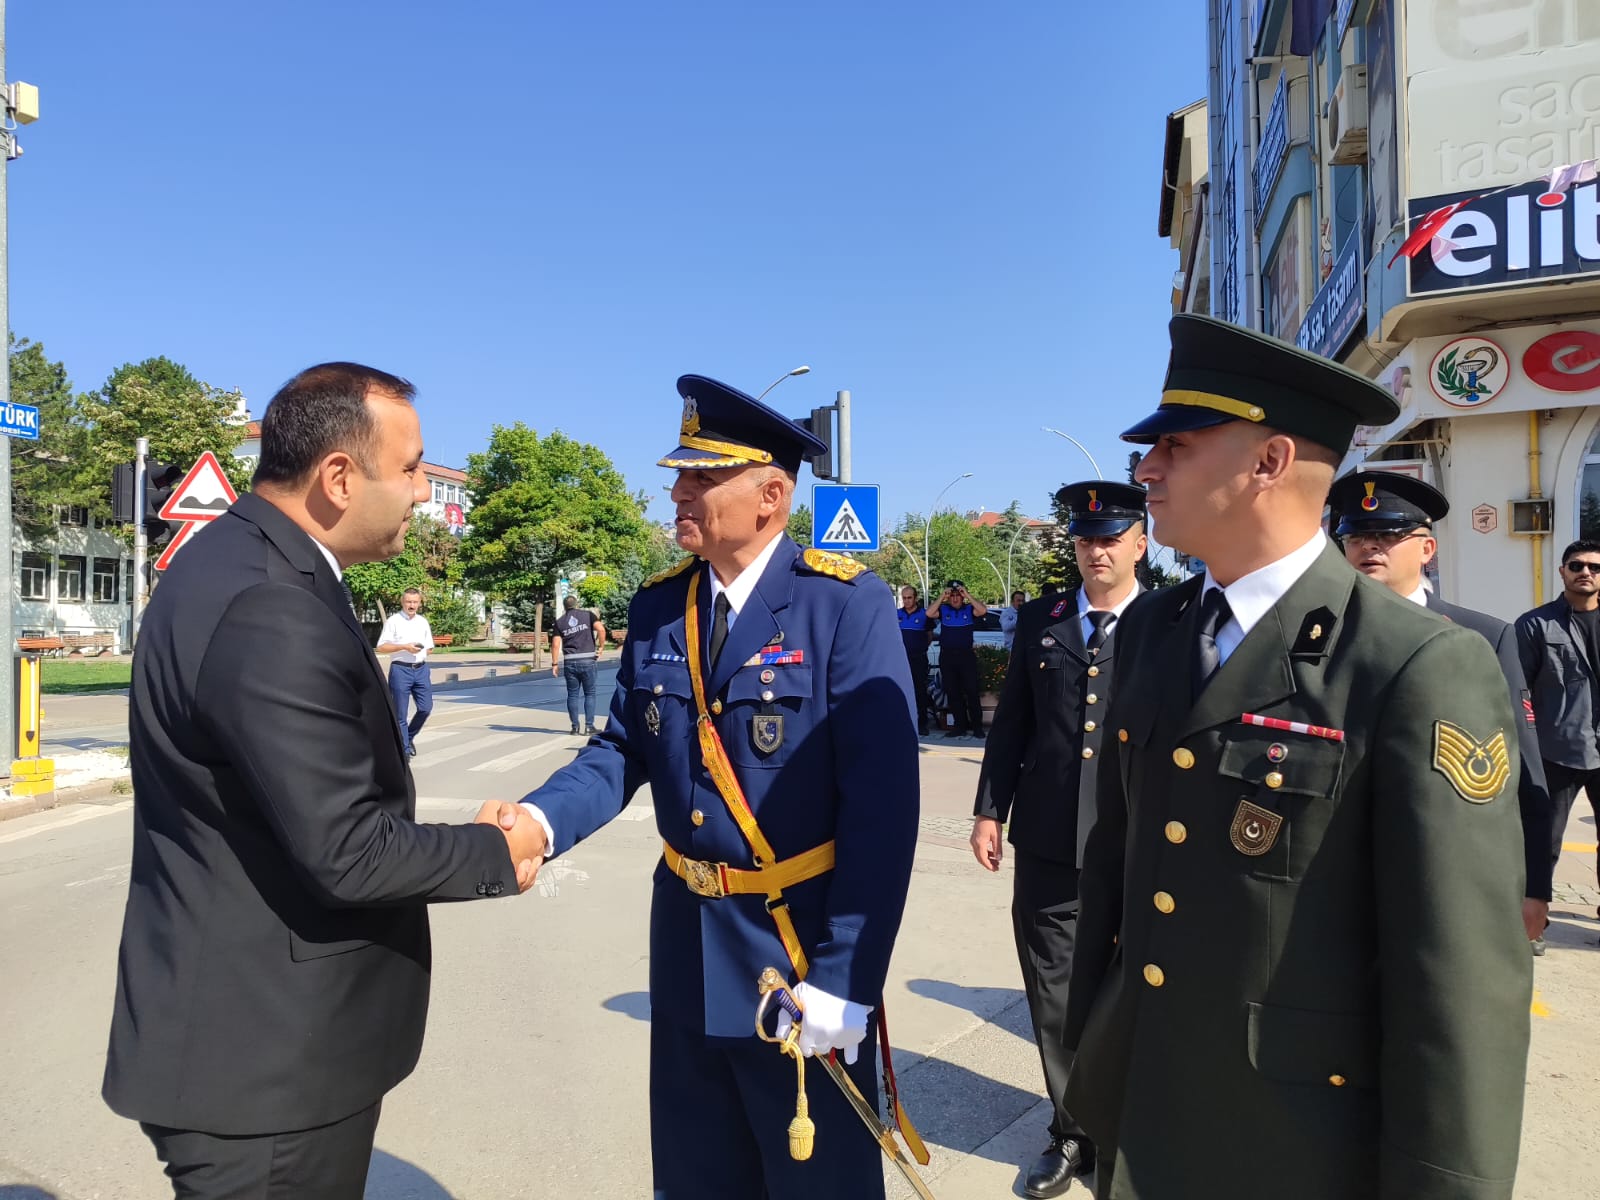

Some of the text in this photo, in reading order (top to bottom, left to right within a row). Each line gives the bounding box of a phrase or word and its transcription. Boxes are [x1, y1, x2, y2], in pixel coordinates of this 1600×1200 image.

[1311, 303, 1325, 349] saç
[1327, 249, 1357, 327] tasarım
[562, 624, 588, 636] ZABITA
